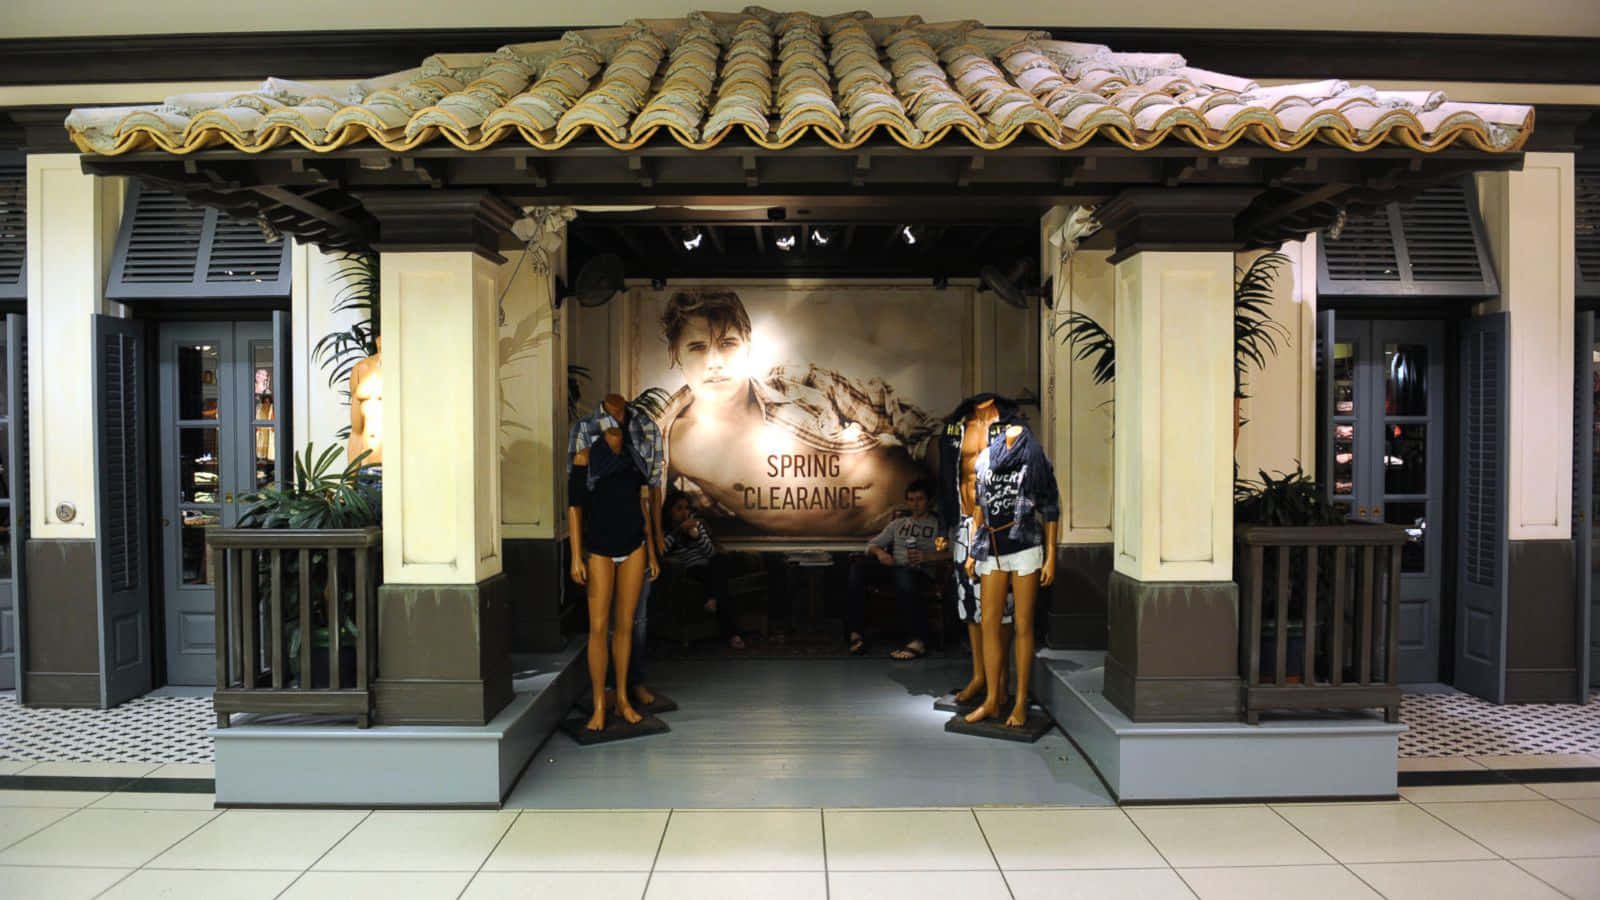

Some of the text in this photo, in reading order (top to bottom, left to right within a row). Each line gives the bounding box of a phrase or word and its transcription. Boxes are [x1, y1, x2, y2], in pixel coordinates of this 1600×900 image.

[767, 454, 841, 478] SPRING
[743, 486, 865, 510] CLEARANCE
[898, 523, 935, 539] HCO
